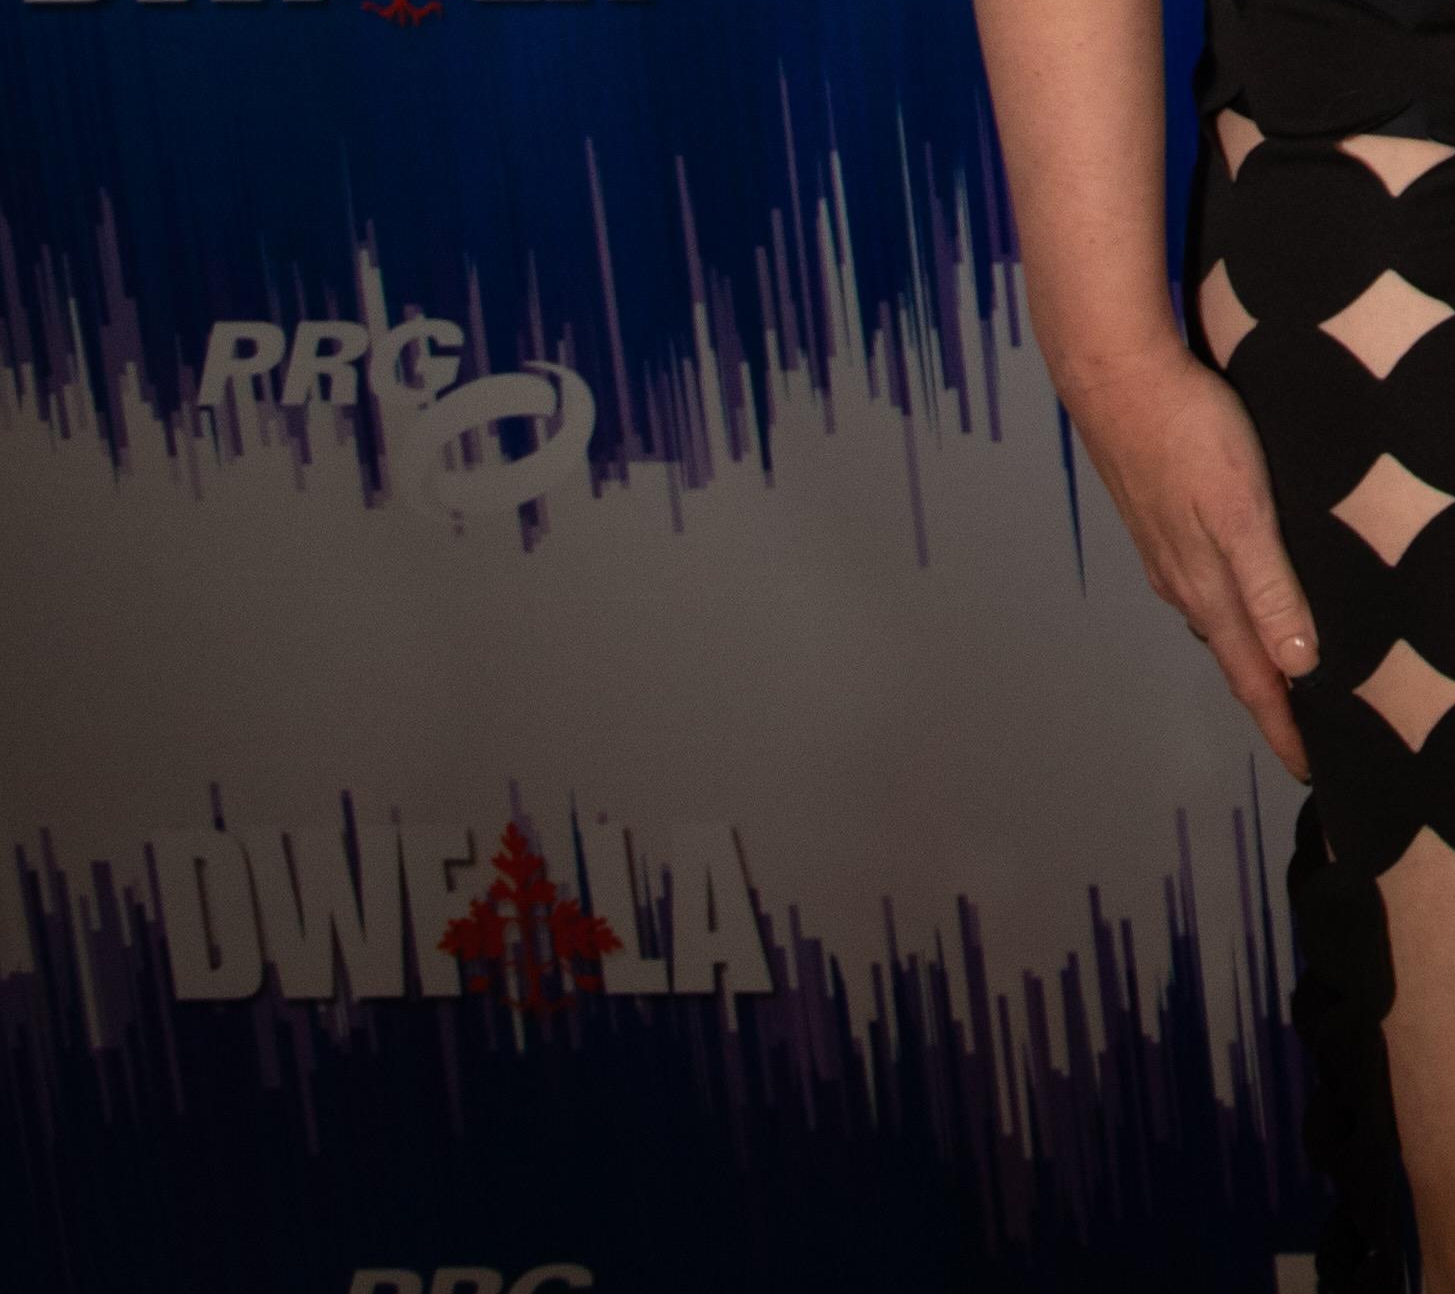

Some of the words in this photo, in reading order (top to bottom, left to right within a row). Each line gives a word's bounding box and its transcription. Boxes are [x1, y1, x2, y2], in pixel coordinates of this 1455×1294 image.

[196, 317, 465, 410] PRG
[157, 824, 477, 1002] DWF
[578, 824, 777, 998] LA
